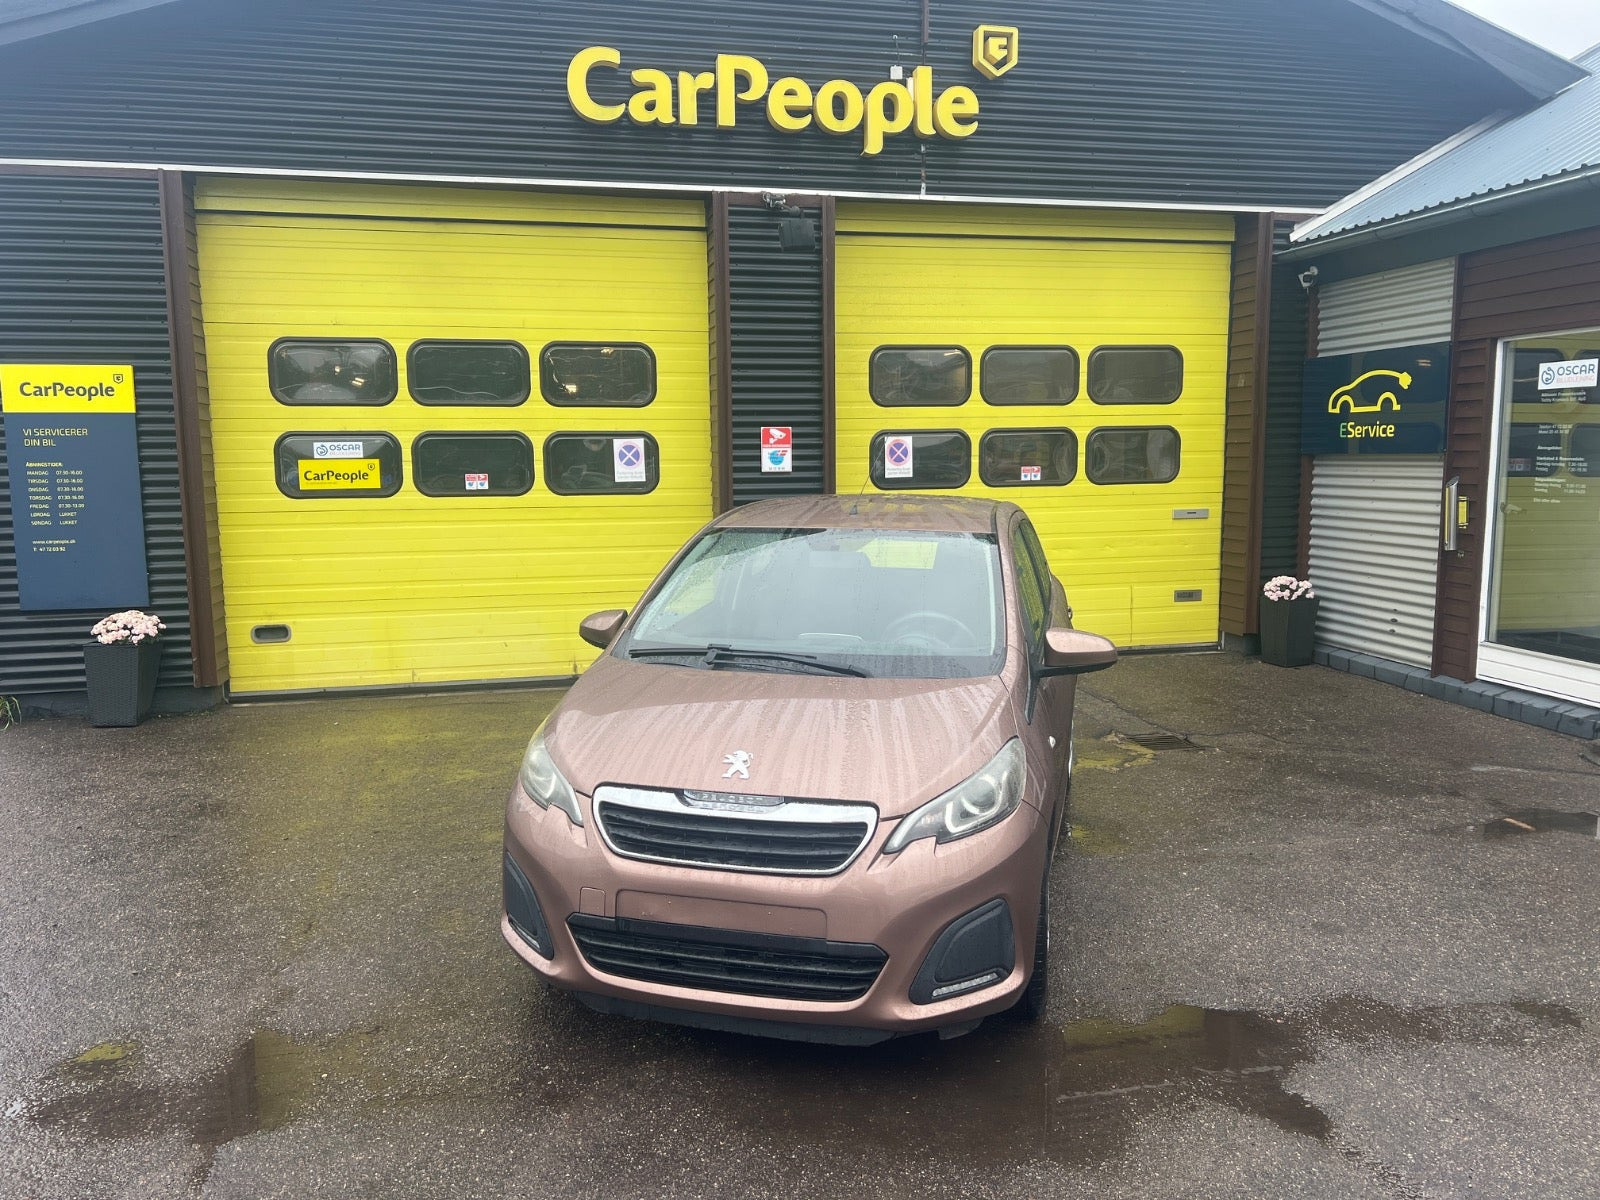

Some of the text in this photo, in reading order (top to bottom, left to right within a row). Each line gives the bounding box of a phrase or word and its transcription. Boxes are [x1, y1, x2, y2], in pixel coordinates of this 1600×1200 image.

[566, 45, 980, 156] CarPeople
[1556, 363, 1596, 376] OSCAR
[19, 381, 115, 402] CarPeople
[22, 428, 88, 437] VI SERVICERER
[1339, 420, 1395, 438] EService
[24, 439, 56, 448] DIN BIL
[303, 470, 369, 483] CarPeople
